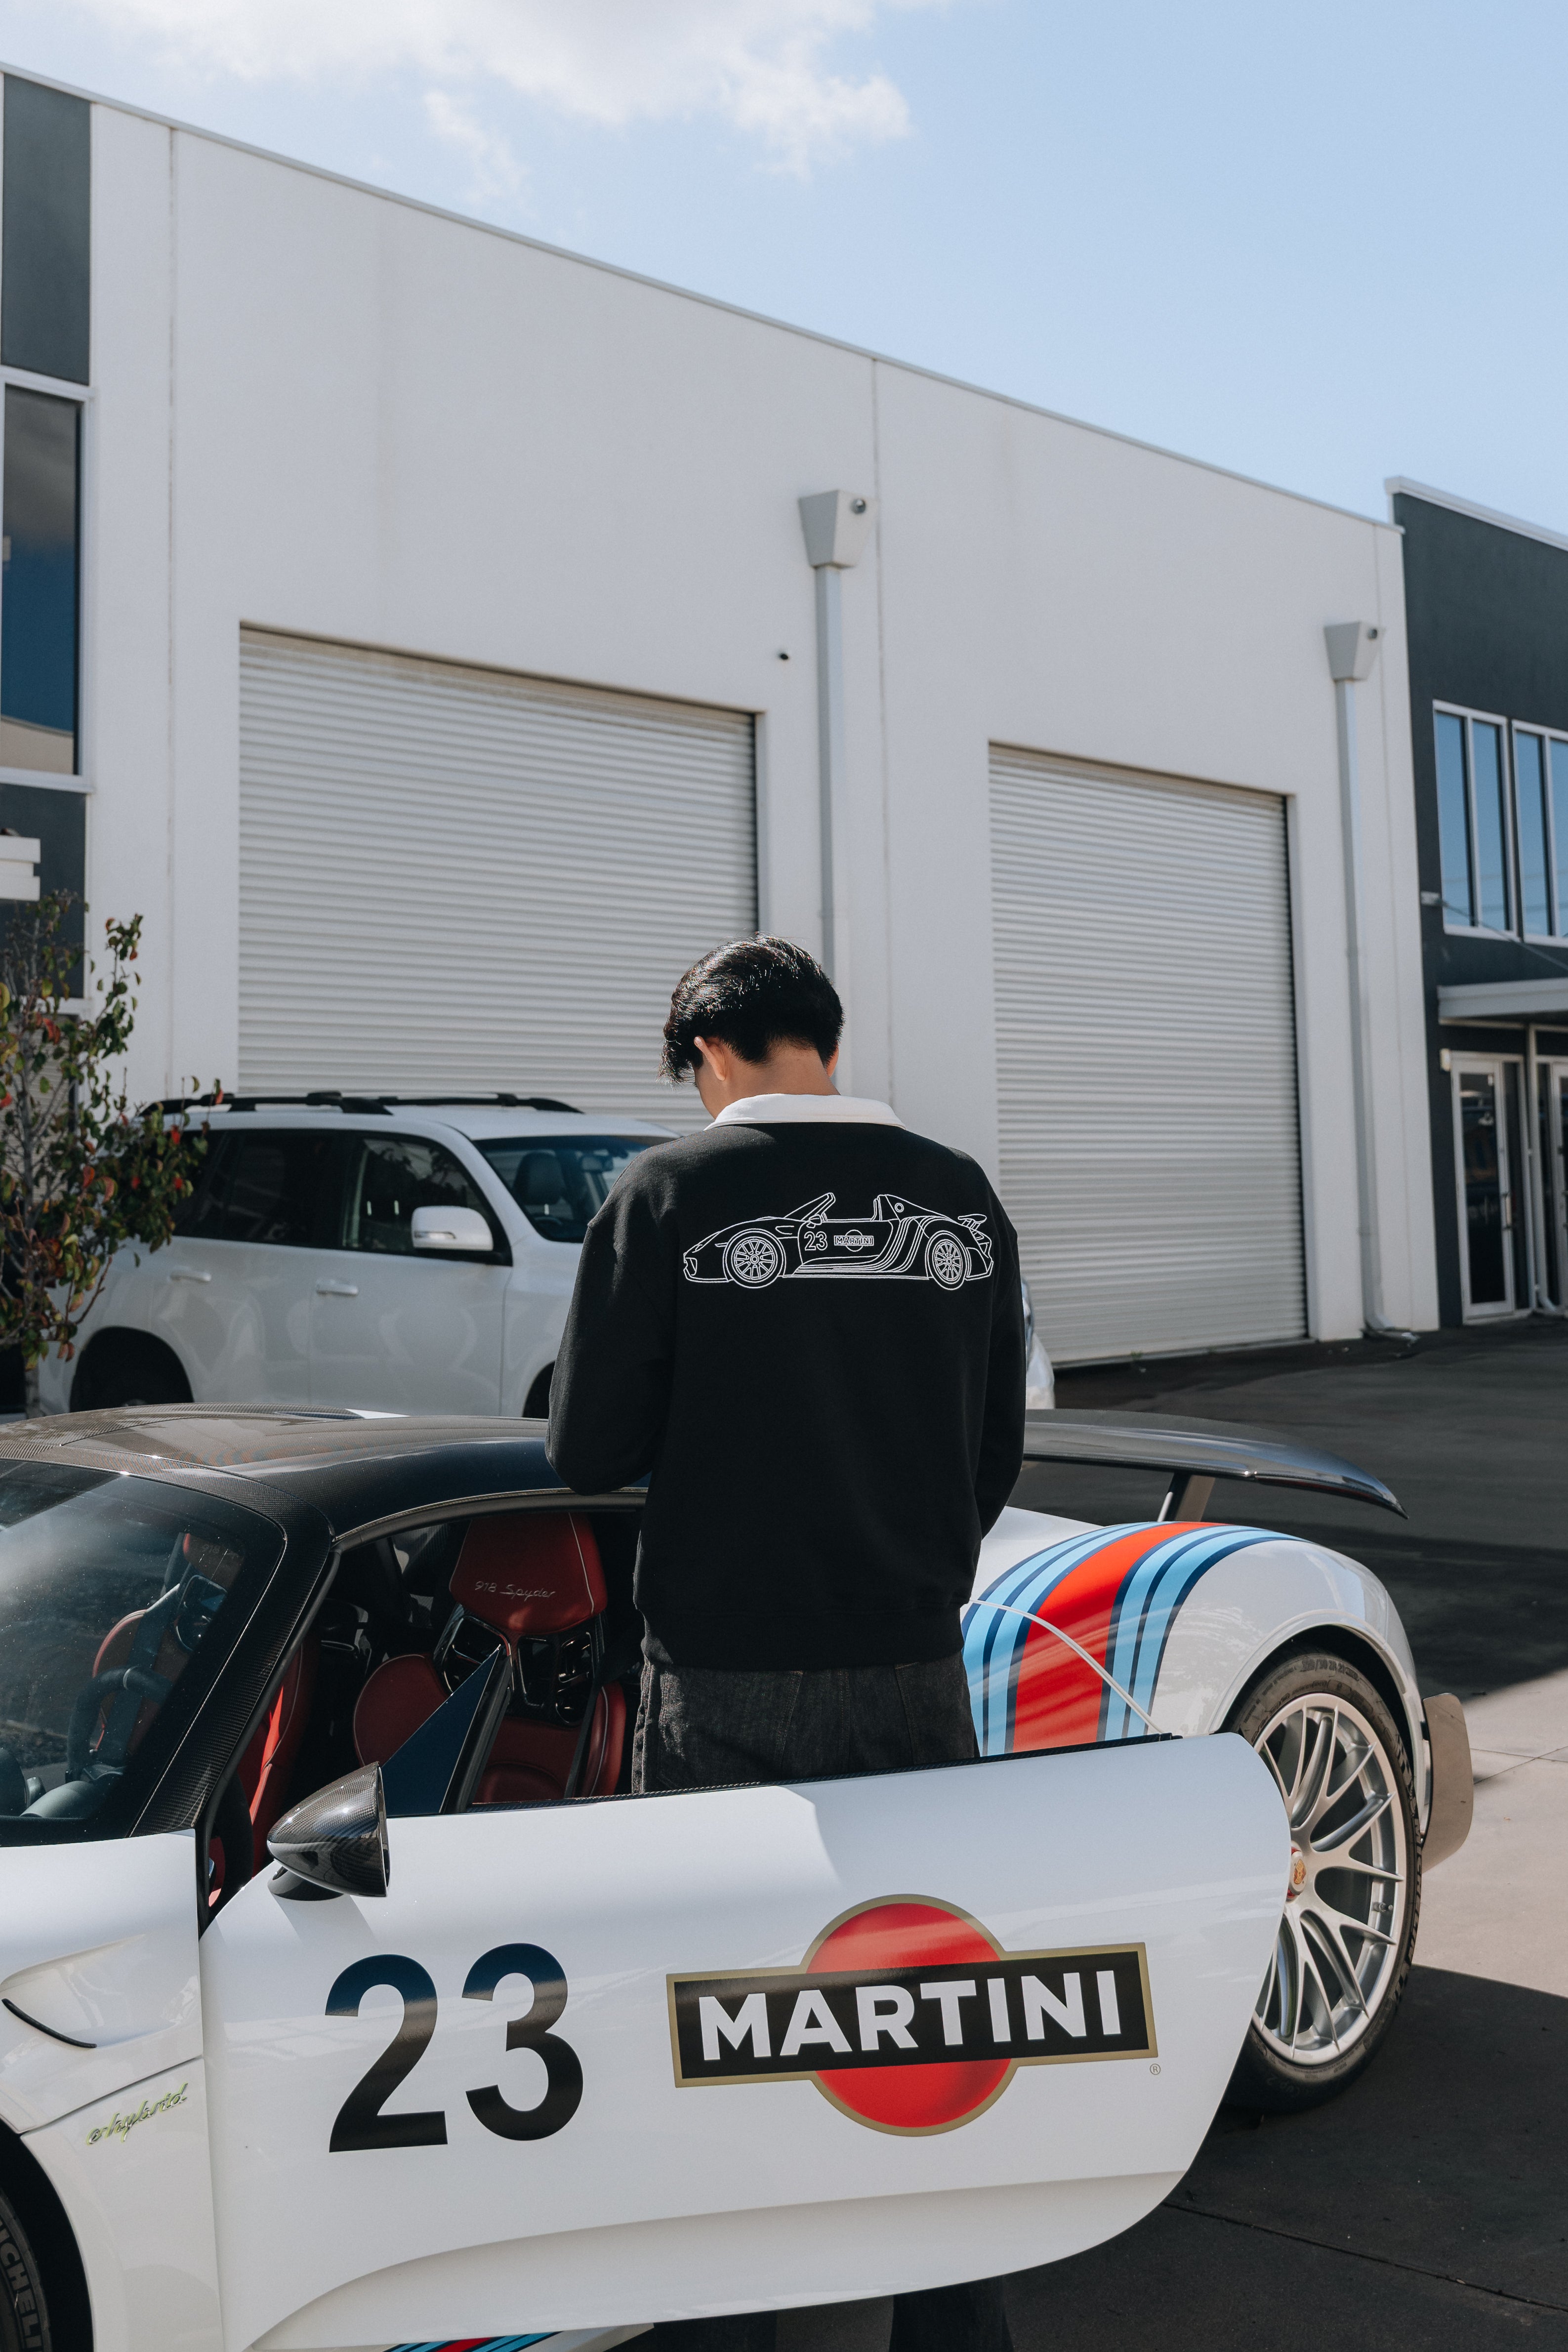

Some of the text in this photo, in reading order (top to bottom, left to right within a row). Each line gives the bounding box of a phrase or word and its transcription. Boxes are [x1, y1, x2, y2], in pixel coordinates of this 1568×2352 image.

[804, 1231, 828, 1251] 23
[835, 1236, 873, 1245] MARTINI
[475, 1581, 556, 1602] 918 Spyder
[1408, 1817, 1422, 1964] MICHELIN
[325, 1942, 584, 2153] 23
[698, 1970, 1121, 2061] MARTINI
[86, 2082, 188, 2145] e-hybrid
[0, 2220, 43, 2352] ICHELI
